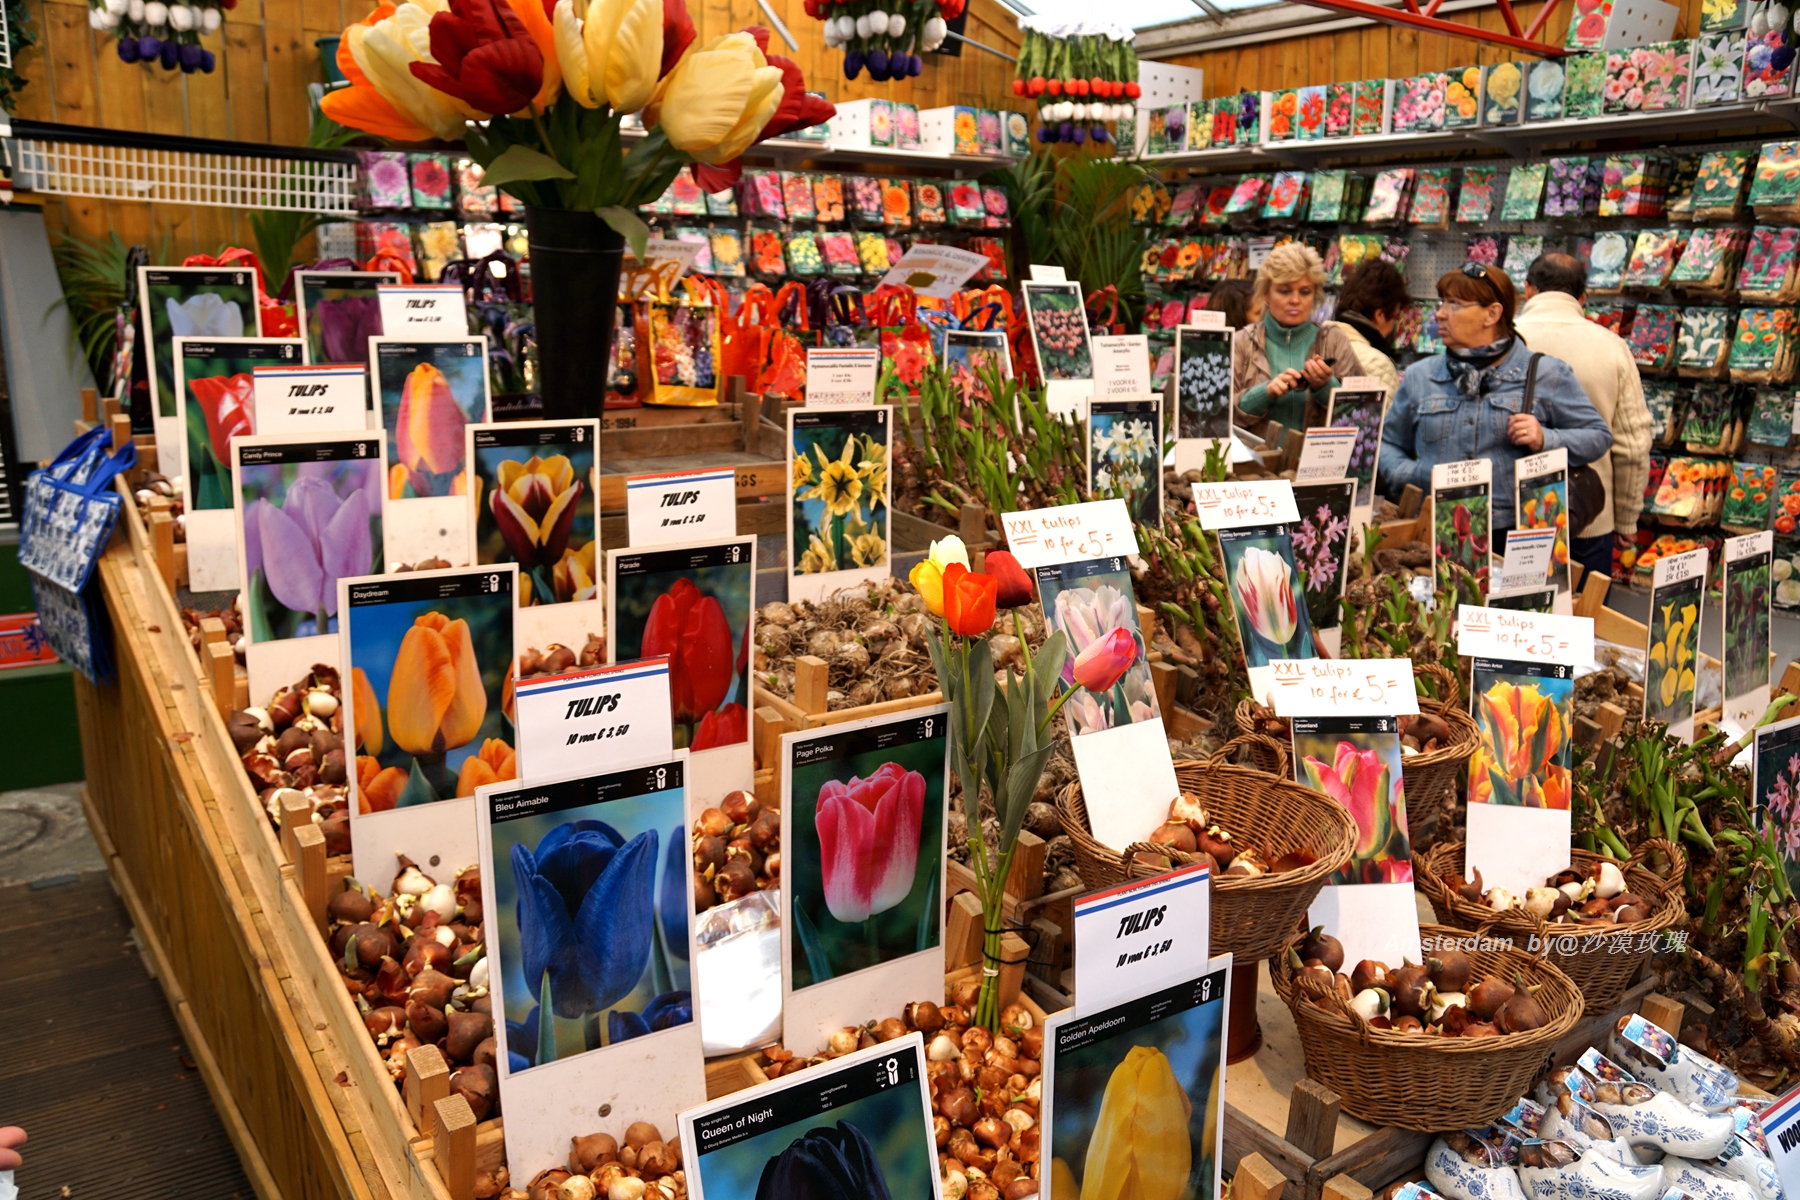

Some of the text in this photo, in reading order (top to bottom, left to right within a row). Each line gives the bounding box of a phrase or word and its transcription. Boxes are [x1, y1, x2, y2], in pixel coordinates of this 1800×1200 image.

[406, 299, 436, 309] TULIPS
[288, 384, 329, 397] TULIPS
[660, 490, 701, 508] TULIPS
[1196, 486, 1253, 501] XXL tulips
[1223, 507, 1233, 517] 10
[1236, 505, 1248, 519] for
[1008, 516, 1081, 535] XXL tulips
[1044, 538, 1055, 549] 10
[1060, 536, 1074, 556] for
[619, 562, 640, 570] Parade
[353, 589, 389, 599] Daydream
[1466, 611, 1534, 631] XXL tulips
[1496, 633, 1509, 643] 10
[1513, 633, 1528, 647] for
[1273, 662, 1352, 680] XXL tulips
[1310, 687, 1324, 698] 10
[1330, 685, 1348, 706] for
[564, 693, 621, 720] TULIPS
[566, 733, 579, 746] 10
[597, 728, 606, 740] €
[796, 744, 834, 758] Page Polka
[495, 795, 549, 813] Bleu Aimable
[1116, 905, 1167, 939] TULIPS
[1116, 953, 1128, 968] 10
[1143, 945, 1152, 959] €
[1060, 1015, 1126, 1045] Golden Apeldoorn
[701, 1113, 730, 1128] Tulip single late
[702, 1108, 773, 1140] Queen of Night
